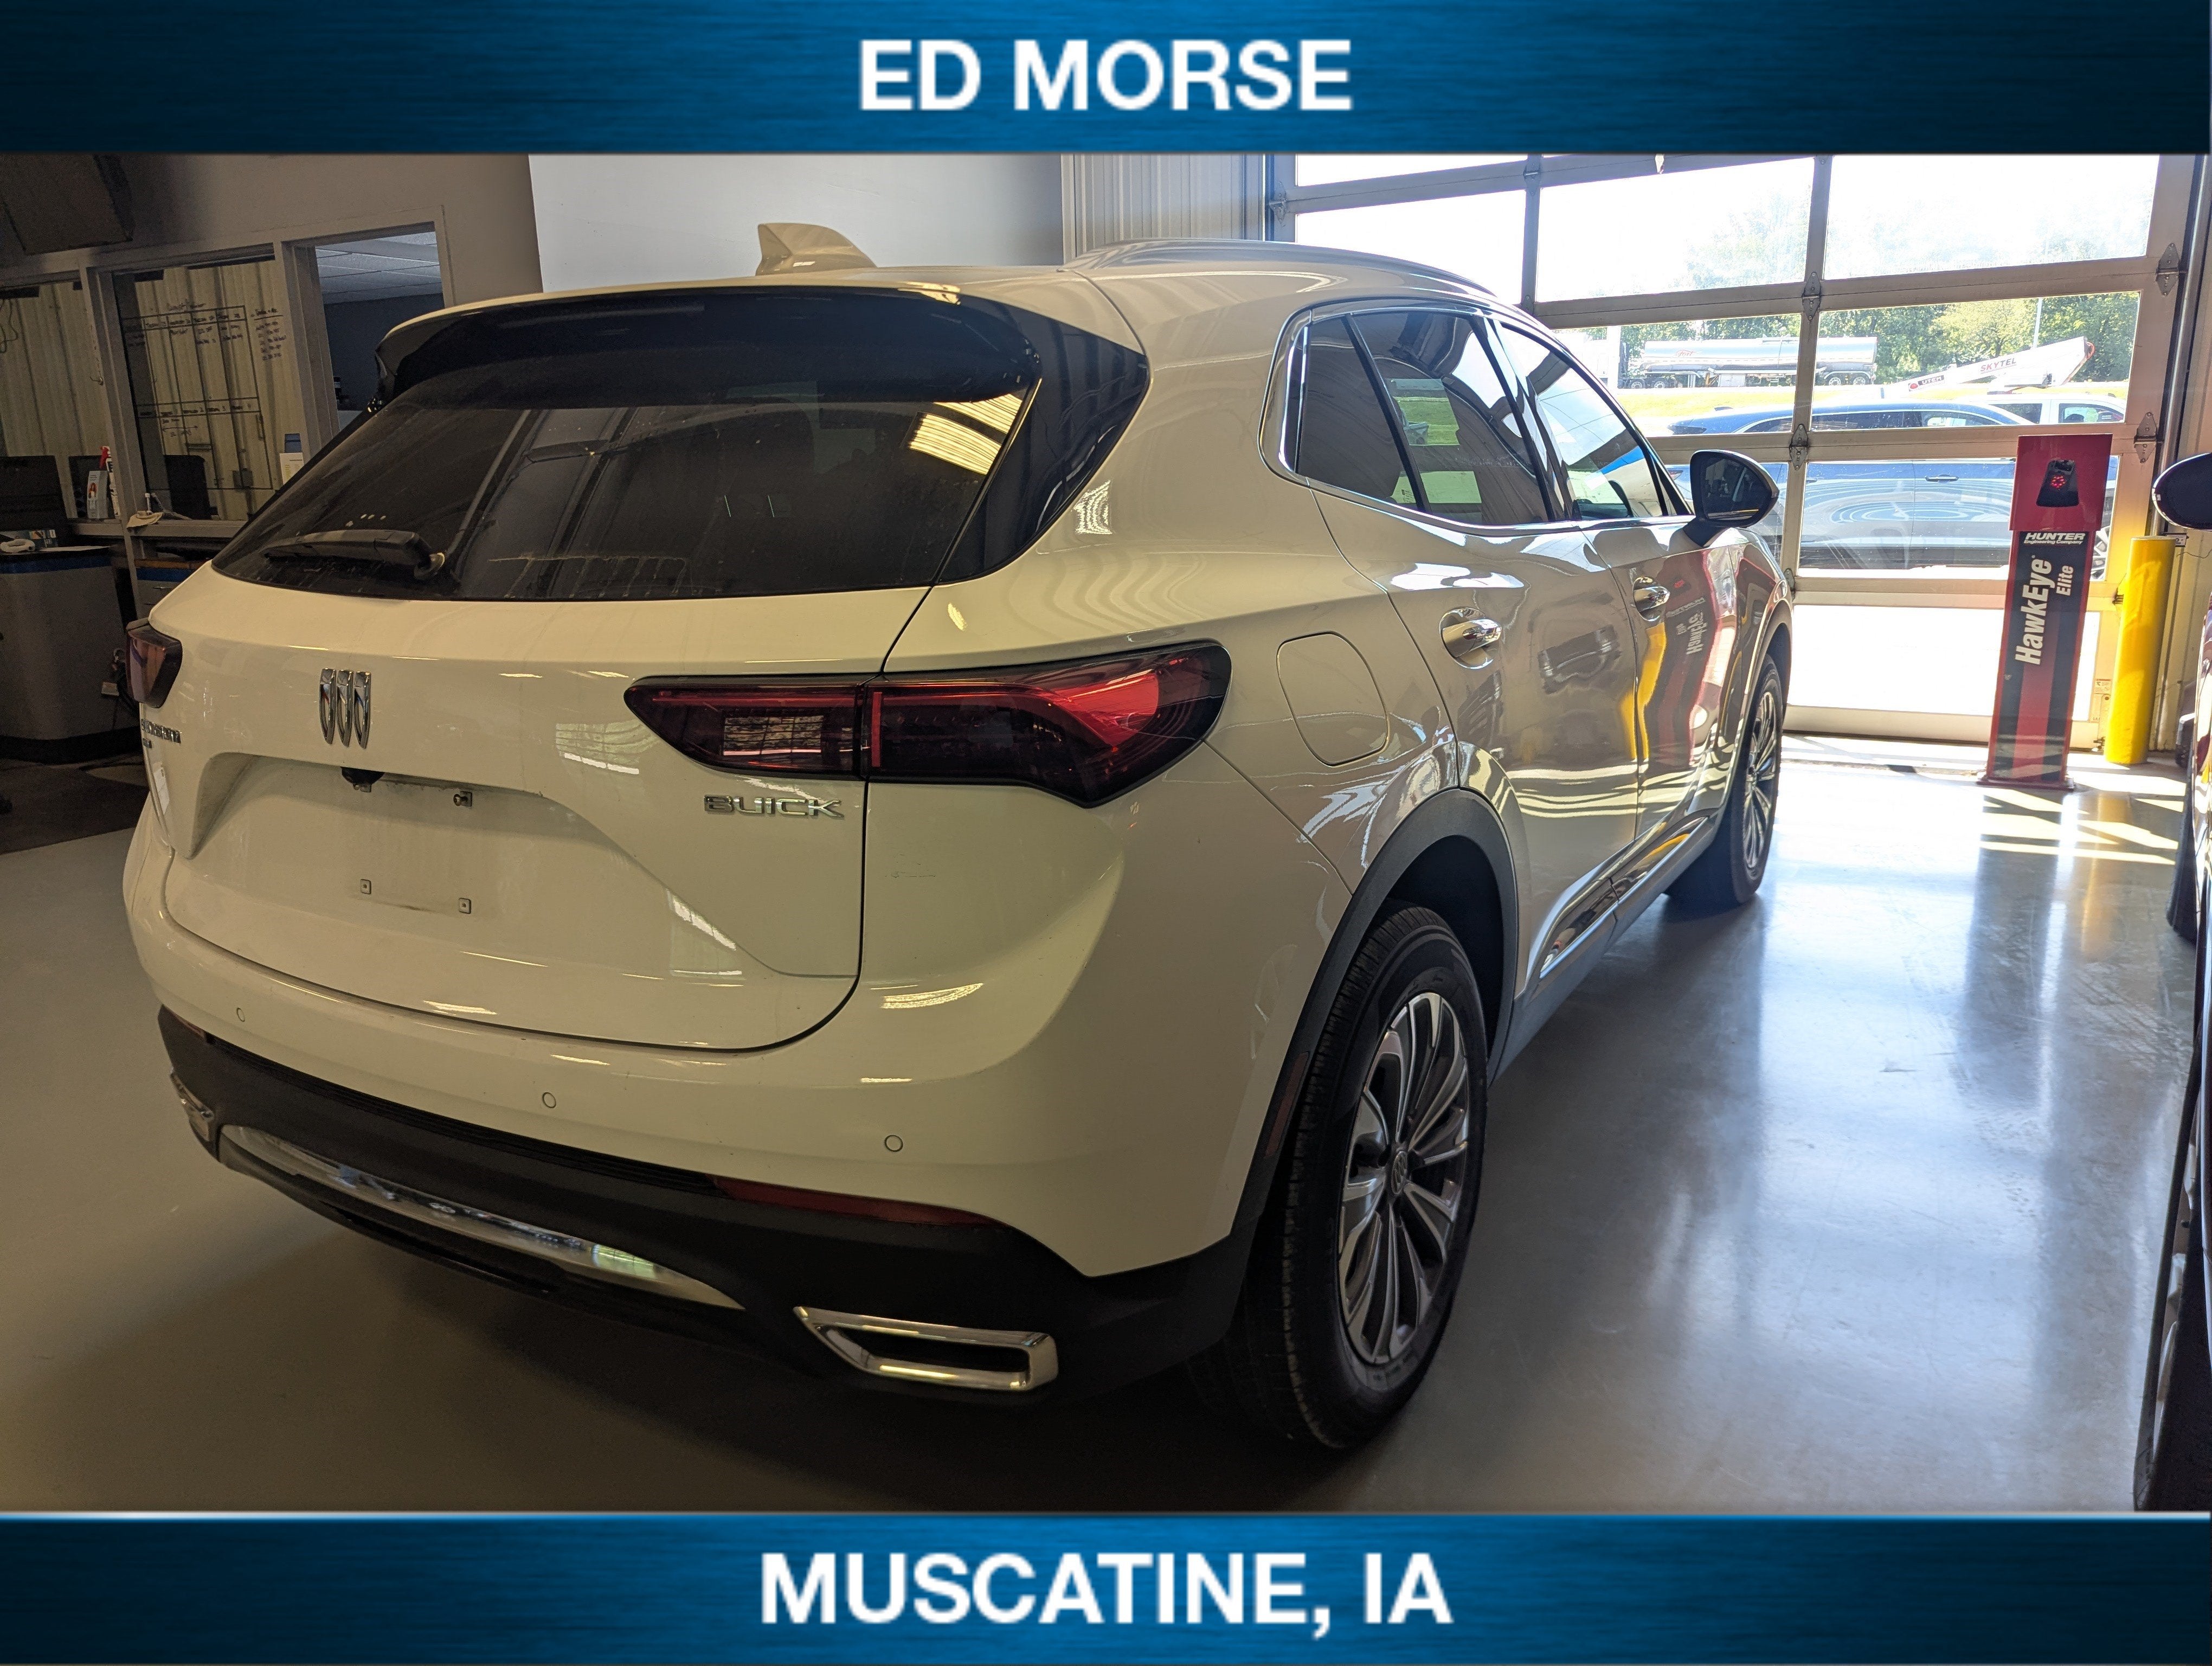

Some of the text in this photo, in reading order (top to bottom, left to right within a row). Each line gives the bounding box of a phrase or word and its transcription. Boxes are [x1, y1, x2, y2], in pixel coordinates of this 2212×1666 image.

[1980, 358, 2016, 371] SKYTEL
[2056, 565, 2074, 597] Elite
[2015, 558, 2055, 665] HawkEye
[704, 795, 844, 819] BUICK
